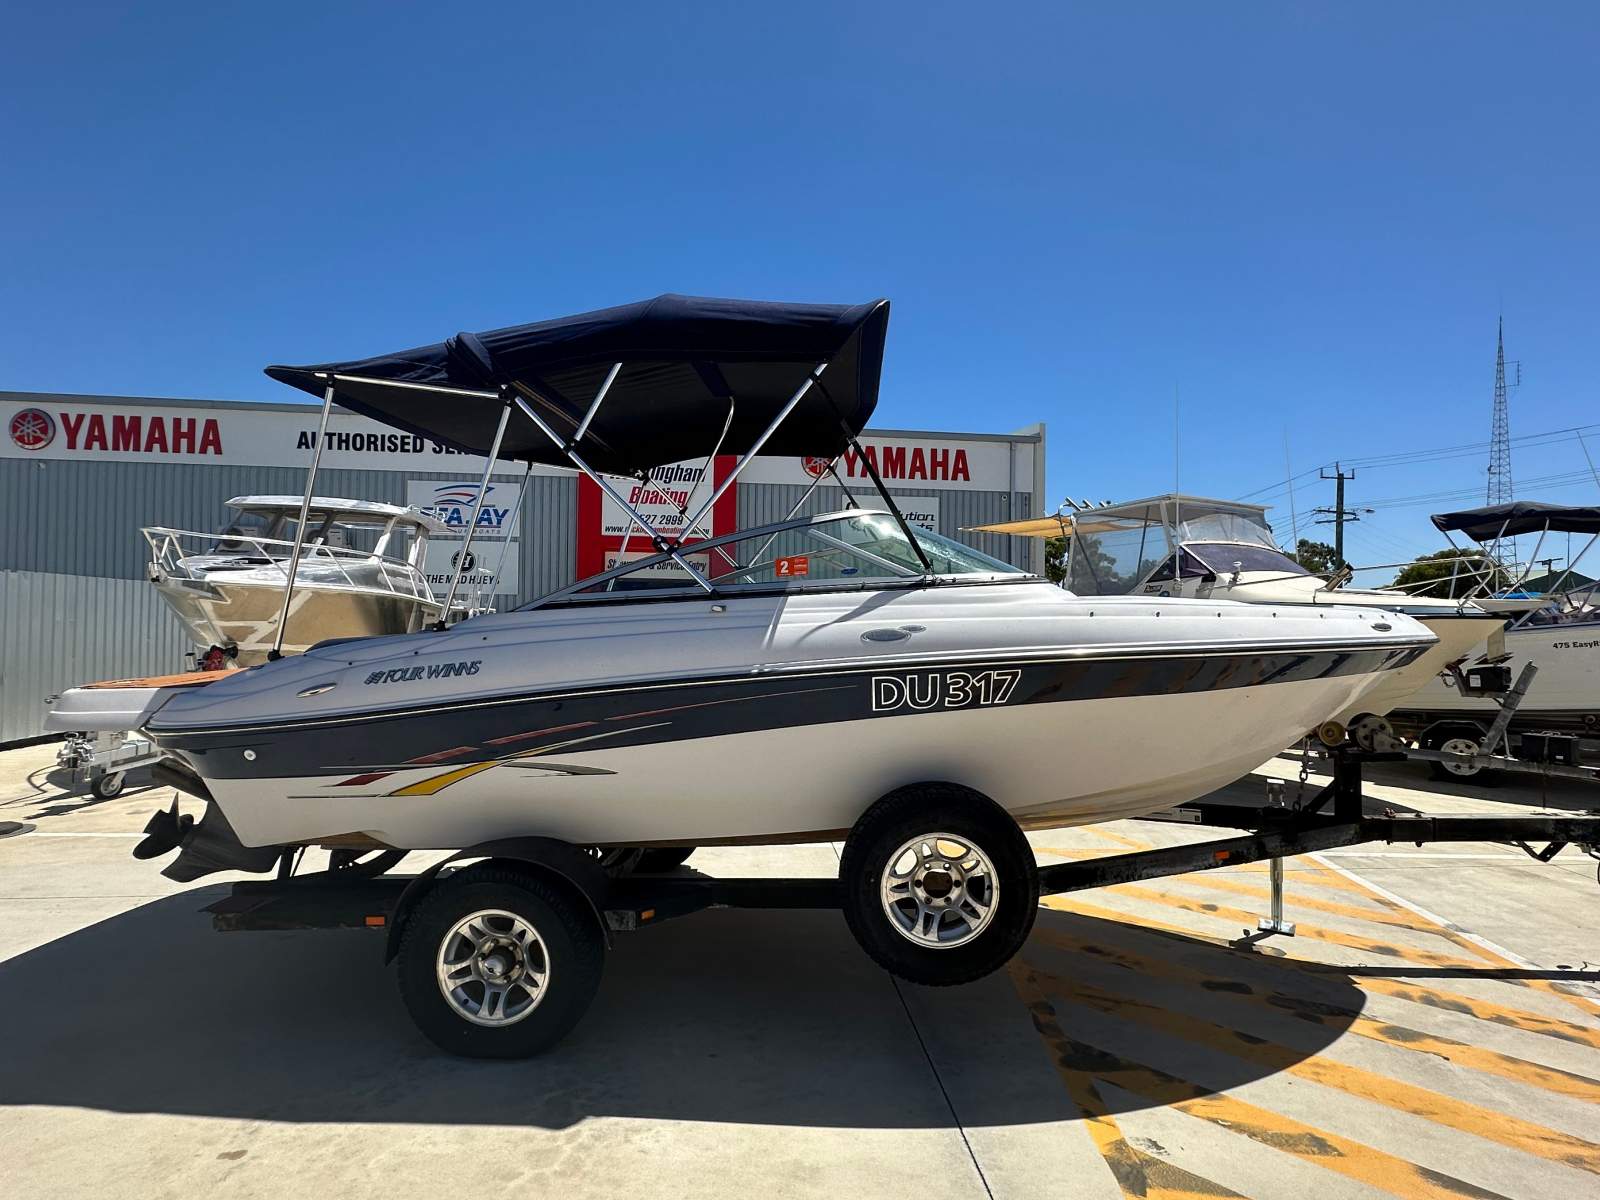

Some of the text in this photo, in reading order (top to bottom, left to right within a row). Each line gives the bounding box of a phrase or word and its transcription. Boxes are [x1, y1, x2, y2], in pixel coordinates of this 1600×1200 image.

[59, 413, 223, 455] YAMAHA
[843, 445, 971, 481] YAMAHA
[660, 515, 684, 525] 2999
[780, 561, 789, 573] 2
[445, 574, 467, 585] MD
[469, 575, 501, 585] HUEY
[382, 661, 483, 683] FOUR WINNS
